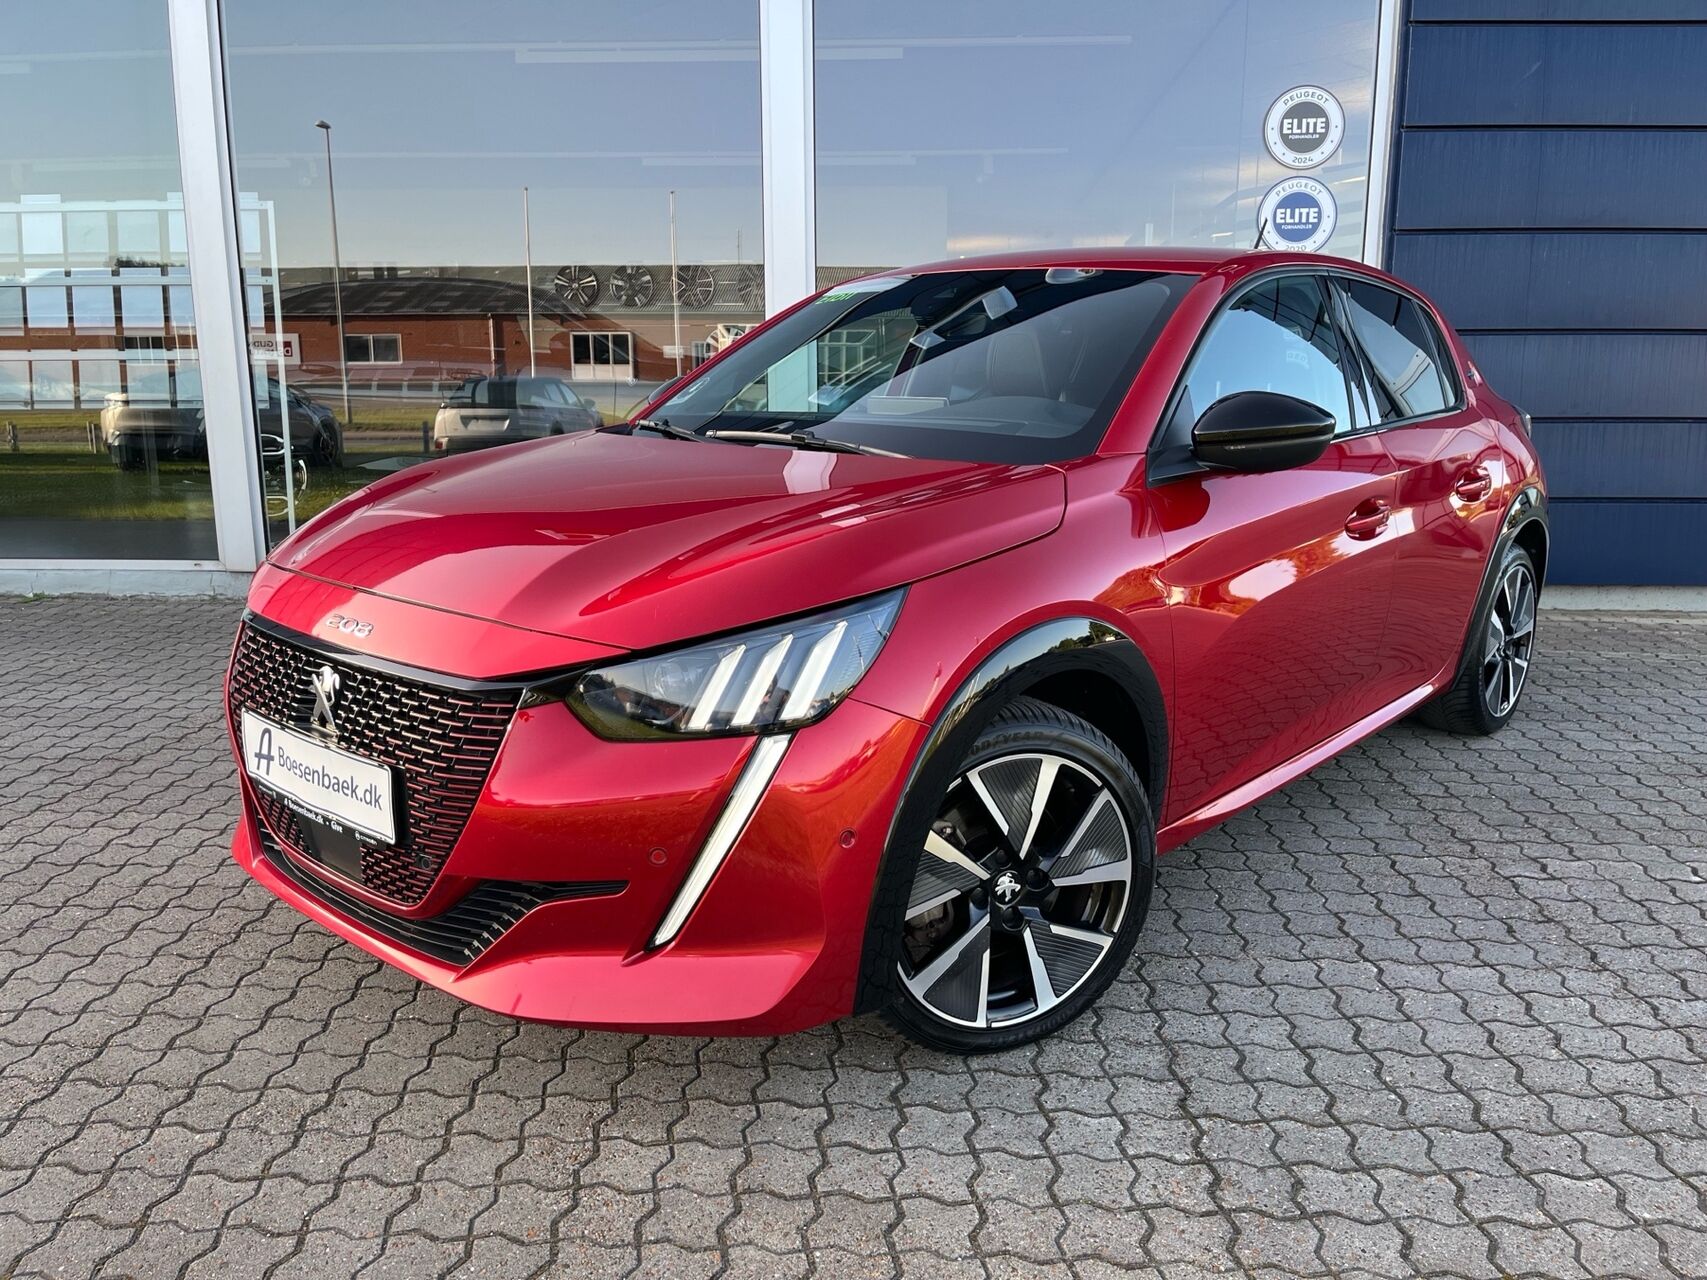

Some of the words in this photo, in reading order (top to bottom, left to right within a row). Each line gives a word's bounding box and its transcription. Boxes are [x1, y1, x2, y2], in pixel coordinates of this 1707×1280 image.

[1283, 91, 1329, 106] PEUGEOT
[1282, 117, 1326, 135] ELITE
[1291, 156, 1315, 164] 2024
[1275, 182, 1323, 197] PEUGEOT
[1275, 207, 1319, 224] ELITE
[326, 613, 374, 638] 208
[278, 746, 383, 811] Boesenbaek.dk
